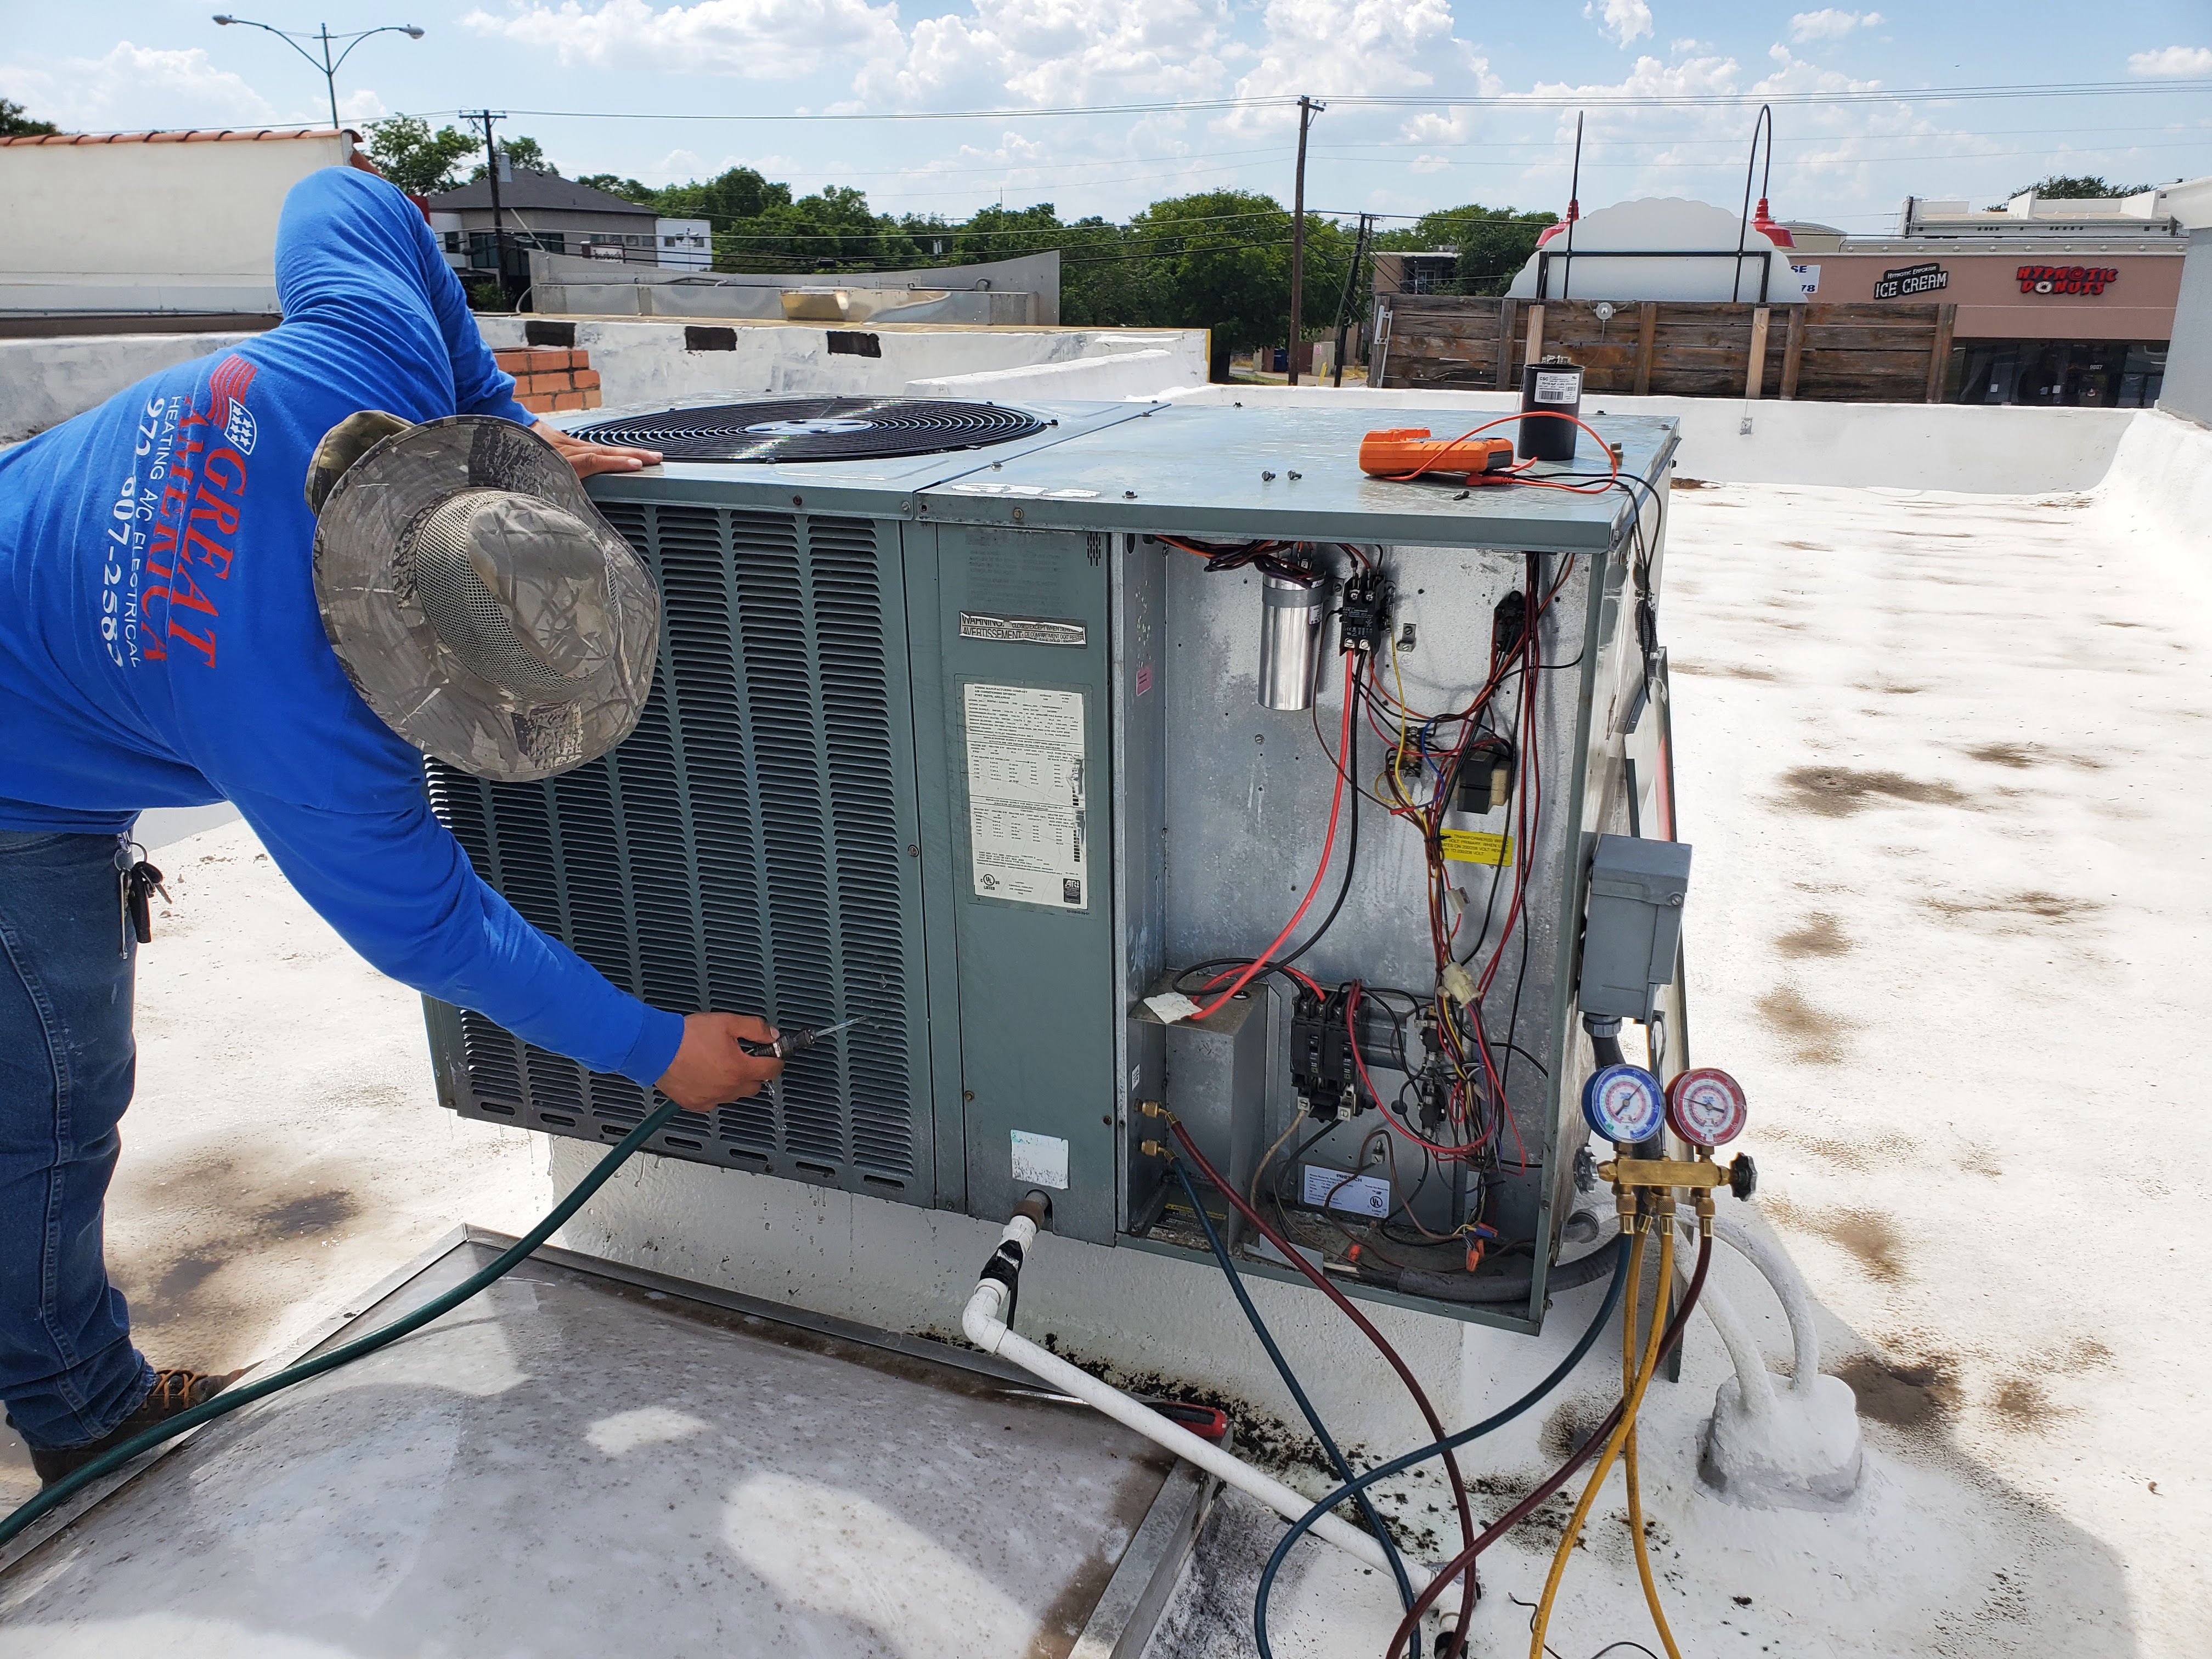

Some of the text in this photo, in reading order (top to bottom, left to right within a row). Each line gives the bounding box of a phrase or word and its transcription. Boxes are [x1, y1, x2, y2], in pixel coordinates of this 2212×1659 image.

[1875, 272, 1947, 298] ICE CREAM
[2016, 266, 2119, 282] HYPNOTIC
[2021, 280, 2104, 295] DONUTS
[124, 396, 182, 668] HEATING A/C ELECTRICAL
[141, 395, 209, 662] AMERICA
[168, 447, 247, 669] GREAT
